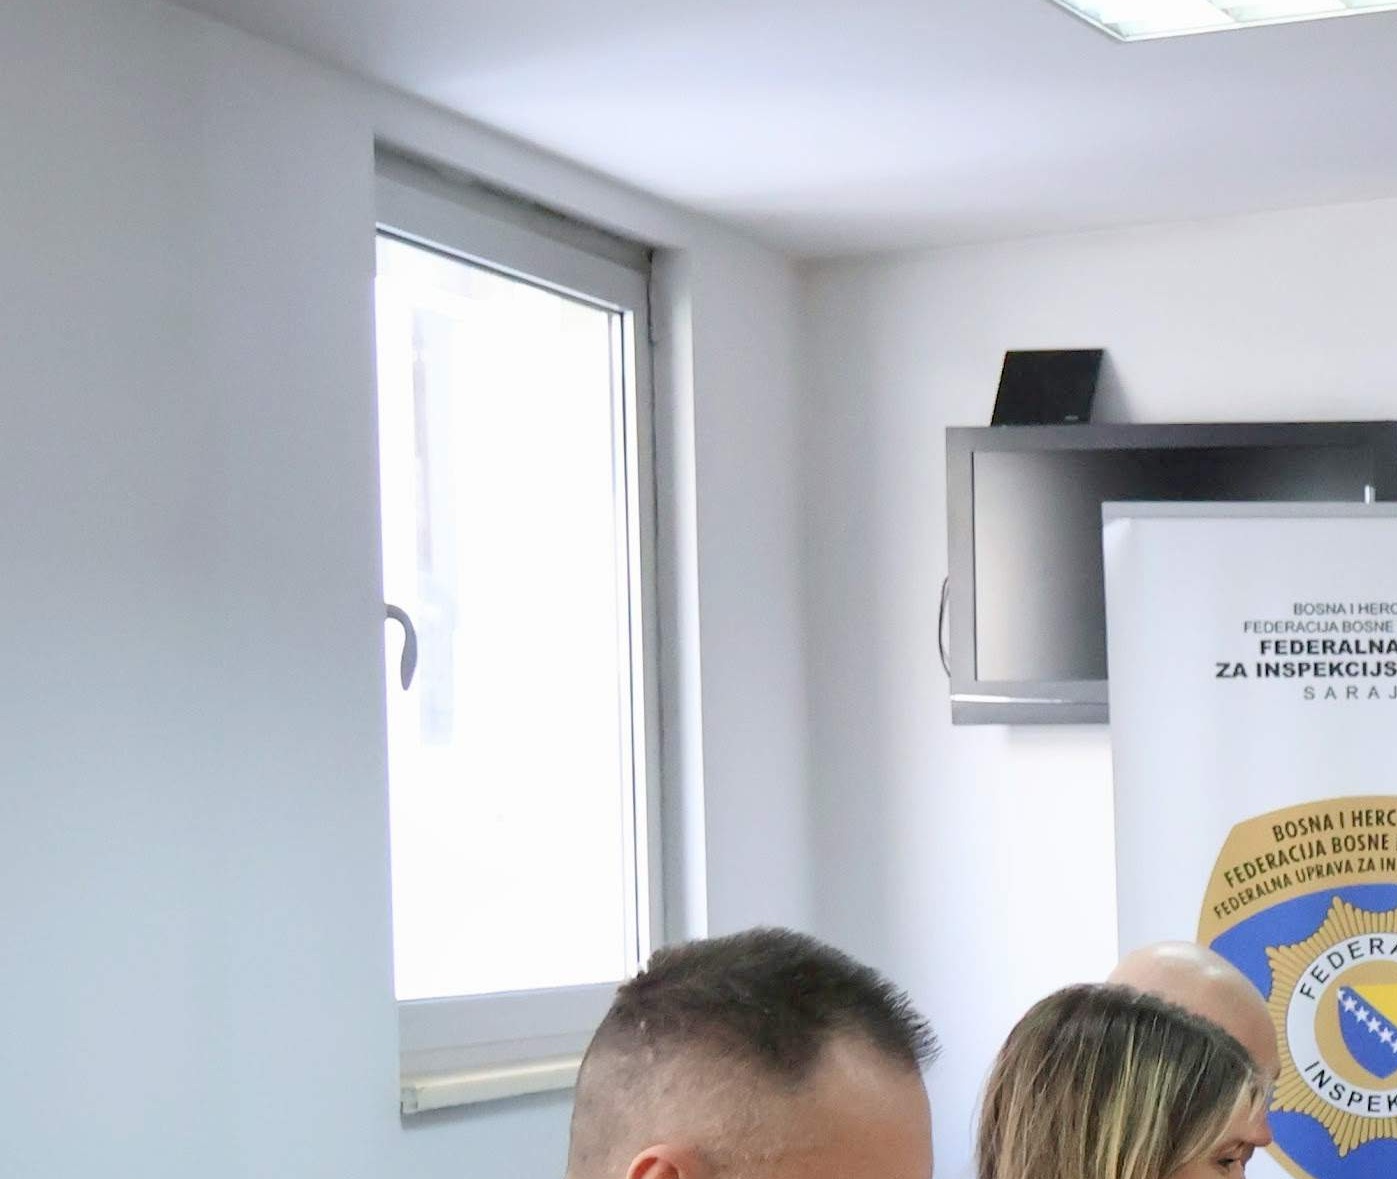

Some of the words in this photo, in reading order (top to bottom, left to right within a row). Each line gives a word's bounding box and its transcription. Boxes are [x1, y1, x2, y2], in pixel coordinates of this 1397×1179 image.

[1292, 602, 1347, 616] BOSNA
[1349, 602, 1355, 615] I
[1243, 620, 1340, 634] FEDERACIJA
[1341, 619, 1393, 634] BOSNE
[1215, 662, 1248, 679] ZA
[1272, 813, 1334, 843] BOSNA
[1339, 811, 1345, 829] I
[1224, 840, 1327, 888] FEDERACIJA
[1331, 833, 1389, 854] BOSNE
[1213, 873, 1293, 920] FEDERALNA
[1295, 860, 1353, 883] UPRAVA
[1357, 857, 1375, 873] ZA
